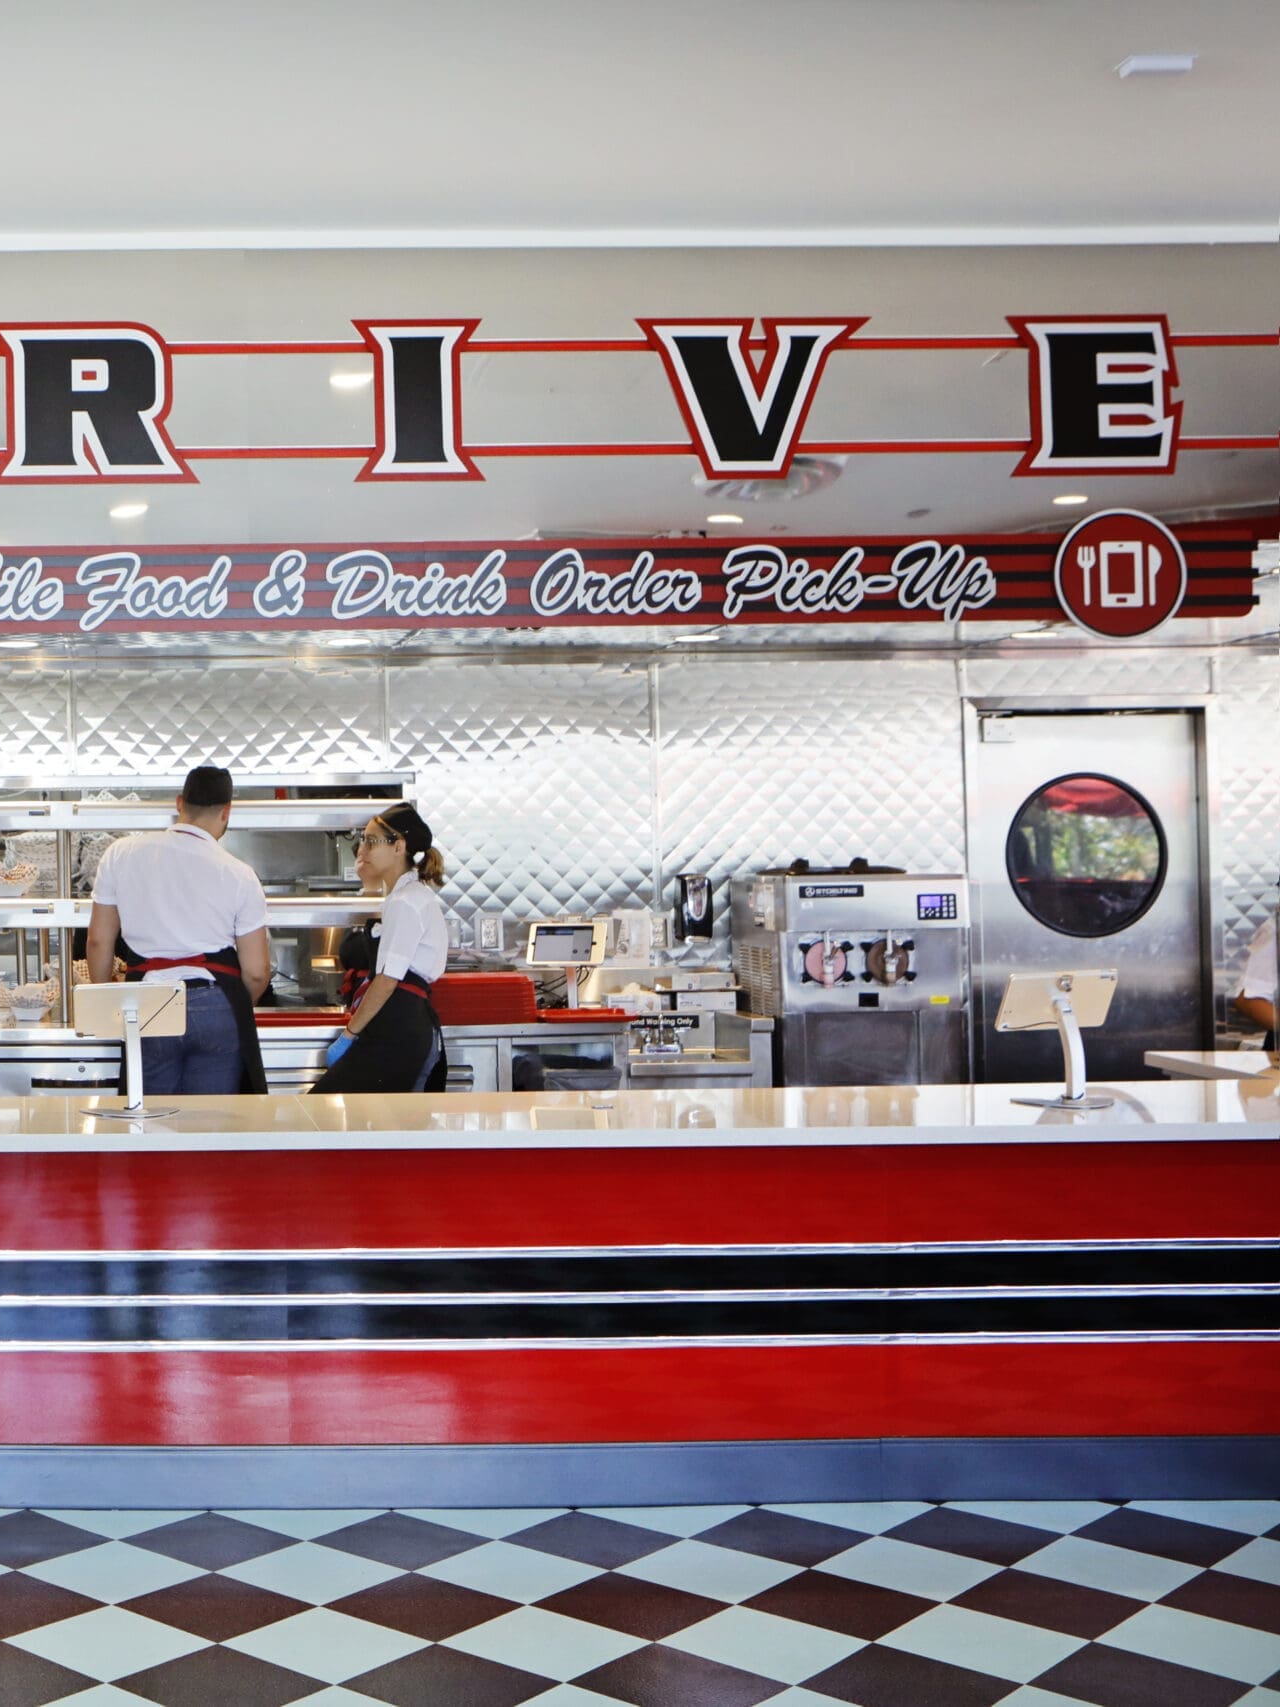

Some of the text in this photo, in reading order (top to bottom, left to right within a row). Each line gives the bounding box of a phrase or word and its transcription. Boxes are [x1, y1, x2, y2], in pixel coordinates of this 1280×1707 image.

[75, 551, 232, 632] Food
[253, 549, 307, 618] &
[326, 549, 507, 620] Drink
[530, 547, 702, 616] Order
[722, 540, 997, 624] Pick-Up
[677, 1018, 694, 1026] Only
